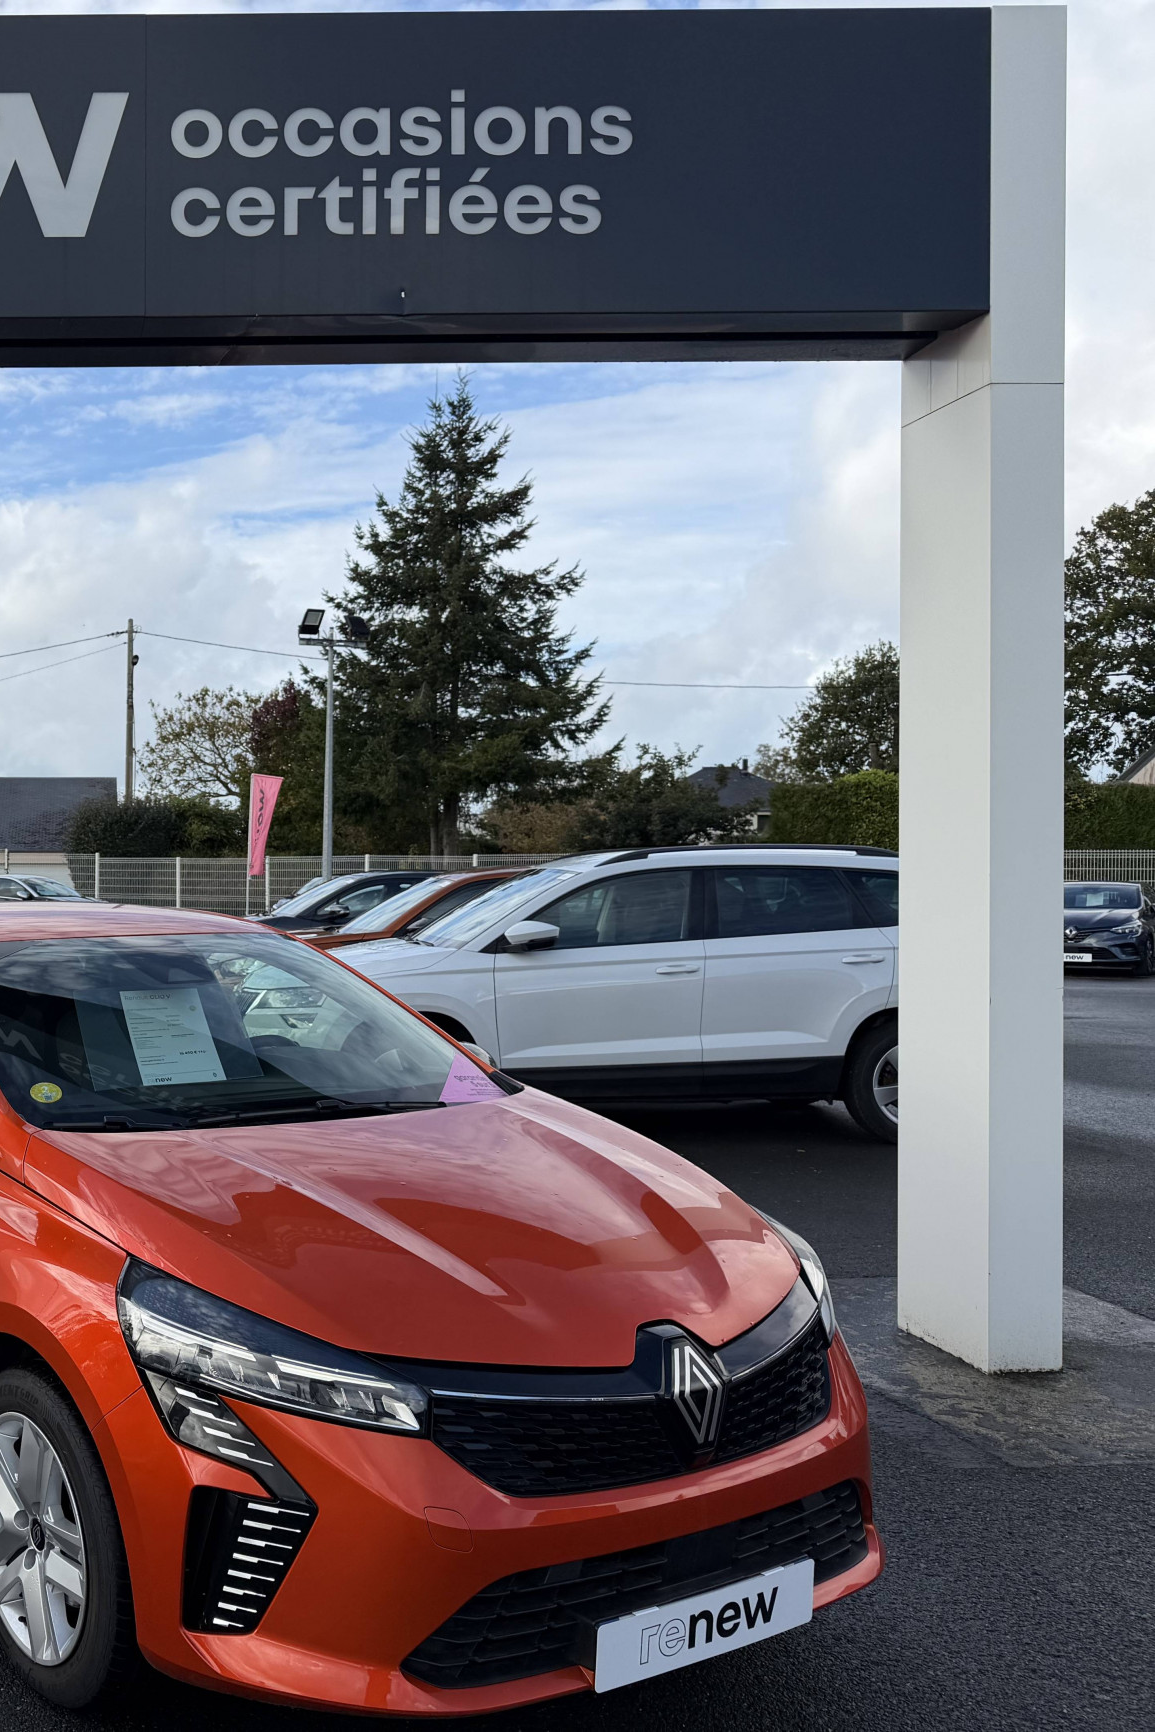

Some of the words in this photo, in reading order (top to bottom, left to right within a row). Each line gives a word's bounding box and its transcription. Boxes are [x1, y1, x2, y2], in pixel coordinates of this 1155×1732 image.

[170, 88, 633, 159] occasions
[170, 167, 602, 237] certifiées
[640, 1586, 779, 1665] renew
